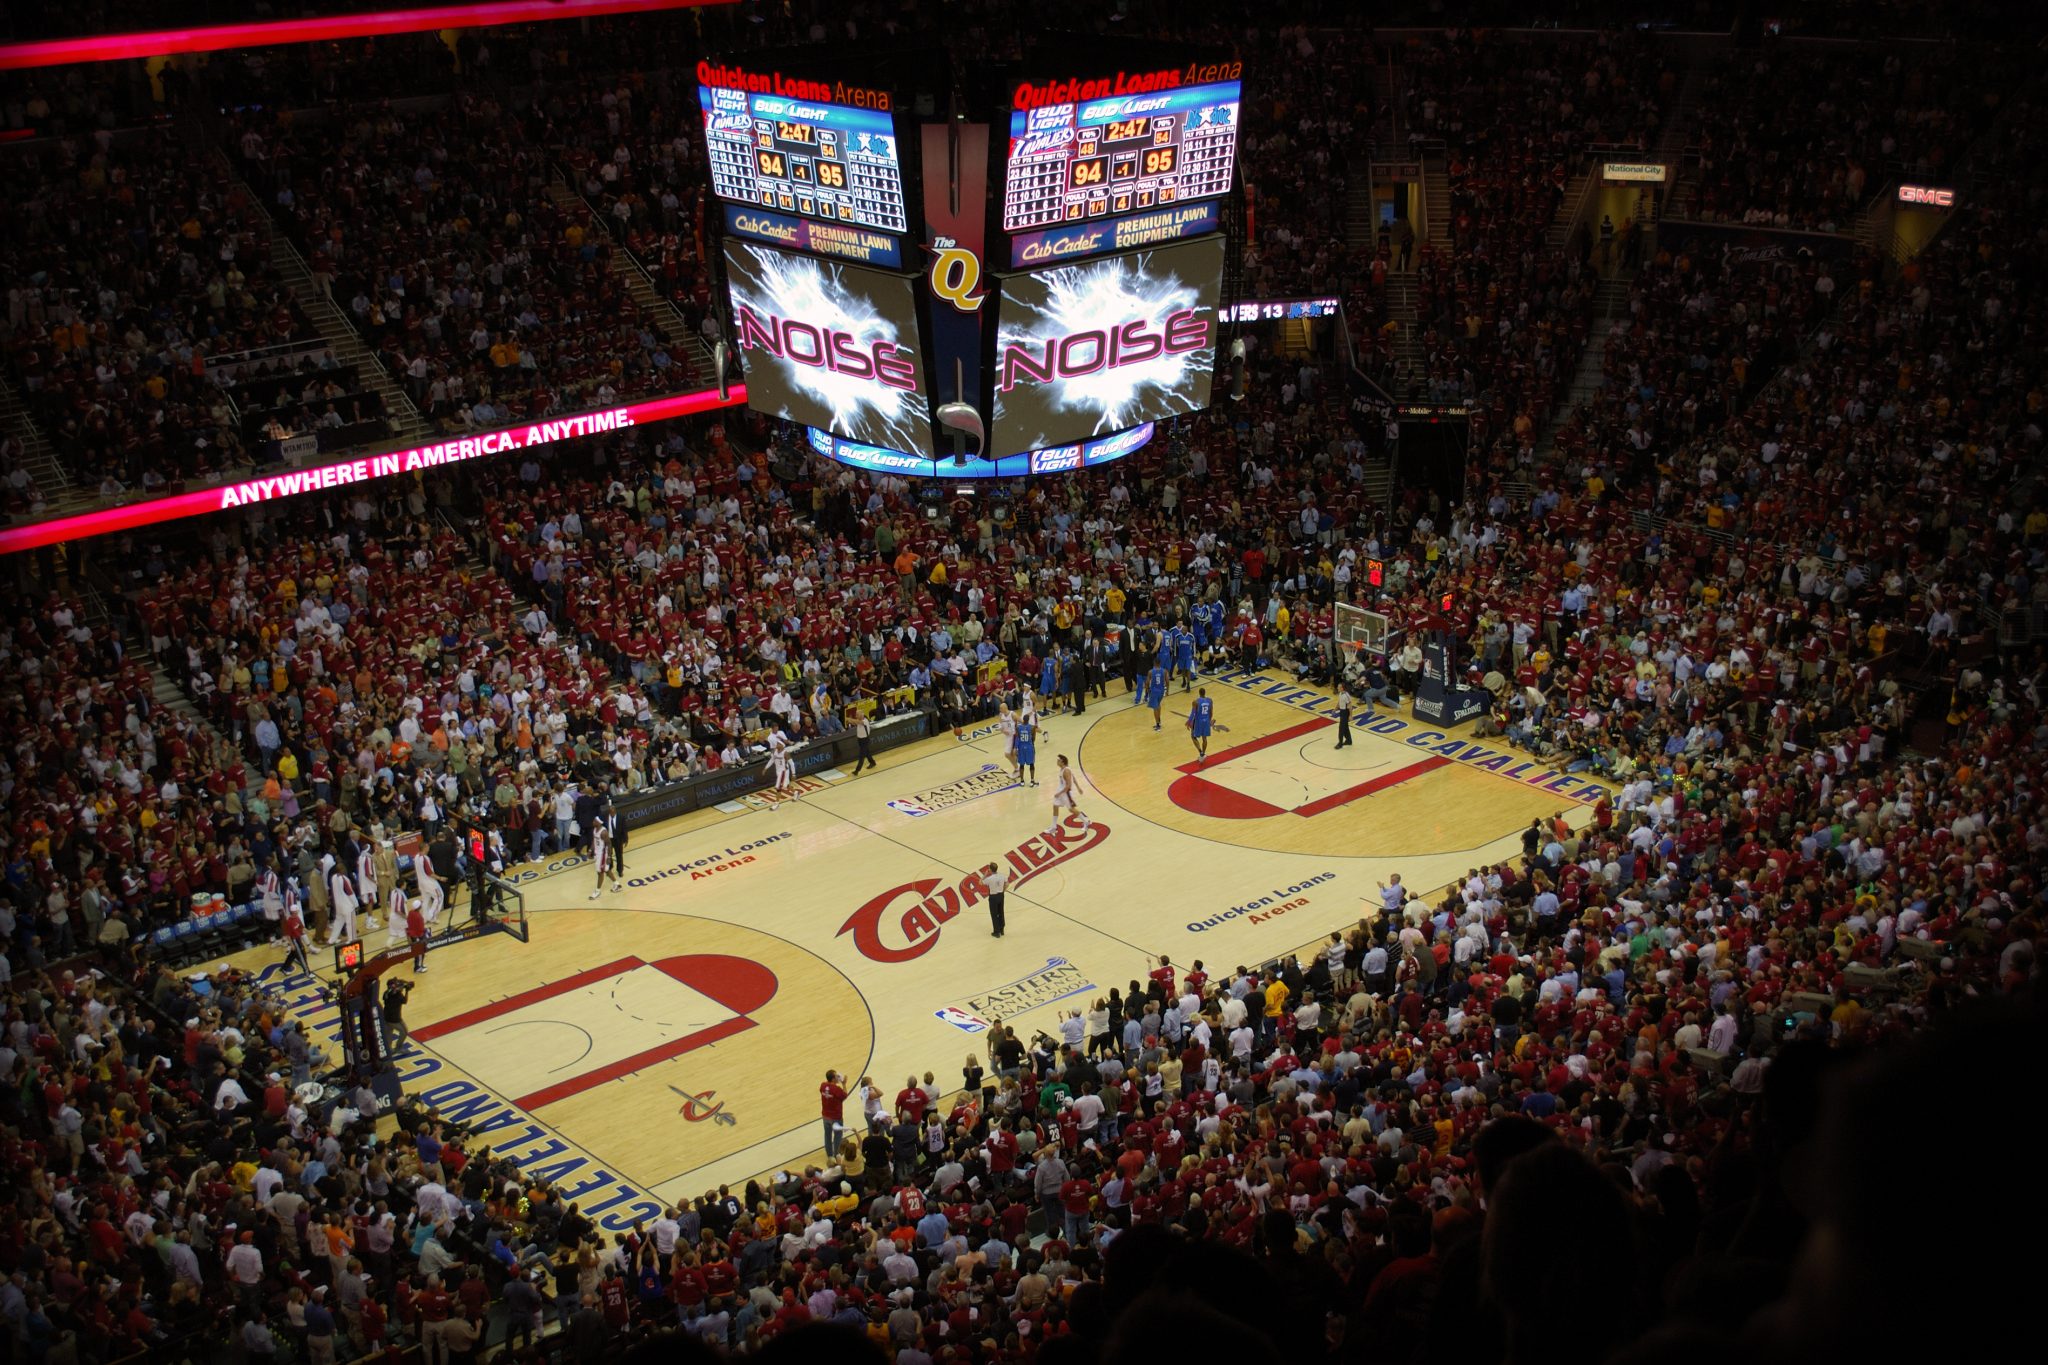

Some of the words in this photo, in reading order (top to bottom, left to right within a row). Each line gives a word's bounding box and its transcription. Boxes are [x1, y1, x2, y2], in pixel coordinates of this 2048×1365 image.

[697, 61, 771, 93] Quicken
[774, 72, 831, 102] Loans
[836, 81, 889, 110] Arena
[718, 89, 746, 100] BUD
[1013, 78, 1110, 112] Quicken
[1114, 69, 1181, 95] Loans
[1183, 61, 1243, 86] Arena
[715, 97, 748, 111] LIGHT
[755, 100, 784, 114] BUD
[788, 106, 829, 121] LIGHT
[1036, 104, 1073, 119] BUD
[1082, 105, 1119, 121] BUD
[1125, 97, 1172, 114] LIGHT
[779, 122, 811, 142] 2:47
[1029, 114, 1074, 130] LIGHT
[1108, 118, 1147, 141] 2:47
[760, 134, 772, 146] 48
[1155, 131, 1169, 144] 54
[1195, 139, 1203, 149] 11
[1215, 136, 1224, 146] 12
[1080, 143, 1095, 155] 48
[760, 154, 783, 177] 94
[795, 167, 806, 179] -1
[819, 164, 843, 187] 95
[1010, 168, 1020, 179] 23
[1075, 161, 1102, 186] 94
[1117, 163, 1129, 176] -1
[1146, 150, 1172, 174] 95
[1183, 164, 1191, 174] 12
[1202, 161, 1211, 171] 13
[1608, 165, 1643, 175] National
[1644, 165, 1661, 176] City
[1010, 180, 1019, 190] 17
[1021, 178, 1030, 189] 12
[1191, 174, 1199, 184] 11
[1009, 193, 1018, 203] 11
[1020, 191, 1029, 201] 10
[1031, 189, 1040, 199] 10
[1066, 192, 1086, 201] FOULS
[1137, 181, 1156, 190] FOULS
[1180, 188, 1189, 198] 20
[1190, 186, 1199, 196] 13
[1899, 186, 1953, 206] GMC
[764, 192, 772, 204] 4
[803, 200, 811, 212] 4
[822, 204, 830, 215] 1
[1008, 205, 1017, 215] 13
[1069, 204, 1079, 217] 4
[1090, 200, 1105, 213] 1/1
[1117, 196, 1127, 209] 4
[1141, 193, 1149, 205] 1
[1160, 187, 1175, 200] 3/1
[735, 216, 758, 233] Cub
[759, 222, 797, 241] Cadet
[1116, 211, 1172, 234] PREMIUM
[1175, 207, 1208, 222] LAWN
[809, 224, 858, 246] PREMIUM
[861, 235, 892, 251] LAWN
[933, 236, 956, 249] The
[1116, 225, 1183, 248] EQUIPMENT
[810, 237, 871, 260] EQUIPMENT
[1022, 238, 1051, 261] Cub
[1052, 234, 1102, 255] Cadet
[929, 246, 991, 311] Q
[1263, 304, 1283, 319] 13
[738, 305, 917, 392] NOISE
[1002, 307, 1208, 392] NOISE
[813, 438, 833, 455] LIGHT
[814, 430, 832, 446] BUD
[1089, 442, 1120, 459] BUD
[1123, 429, 1148, 448] LIGHT
[221, 460, 369, 509] ANYWHERE
[374, 454, 400, 475] IN
[405, 435, 522, 472] AMERICA.
[527, 408, 636, 448] ANYTIME.
[838, 445, 867, 461] BUD
[873, 453, 923, 469] LIGHT
[1034, 456, 1081, 471] LIGHT
[1040, 447, 1079, 461] BUD
[1201, 706, 1209, 715] 12
[1454, 702, 1482, 721] SPALDING
[1020, 734, 1029, 742] 20
[804, 753, 825, 770] JUNE
[825, 752, 832, 762] 6
[914, 768, 1010, 803] EASTERN
[627, 852, 723, 889] Quicken
[724, 830, 793, 858] Loans
[690, 855, 757, 882] Arena
[1186, 896, 1275, 933] Quicken
[1272, 870, 1337, 899] Loans
[1247, 896, 1311, 926] Arena
[968, 963, 1080, 1011] EASTERN
[986, 996, 1046, 1024] FINALS
[1052, 979, 1091, 998] 2009
[931, 1134, 941, 1143] 23
[1049, 1129, 1061, 1141] 23
[420, 1078, 663, 1233] CLEVELAND
[727, 1200, 738, 1216] 6
[908, 1198, 920, 1211] 23
[607, 1293, 622, 1306] 23
